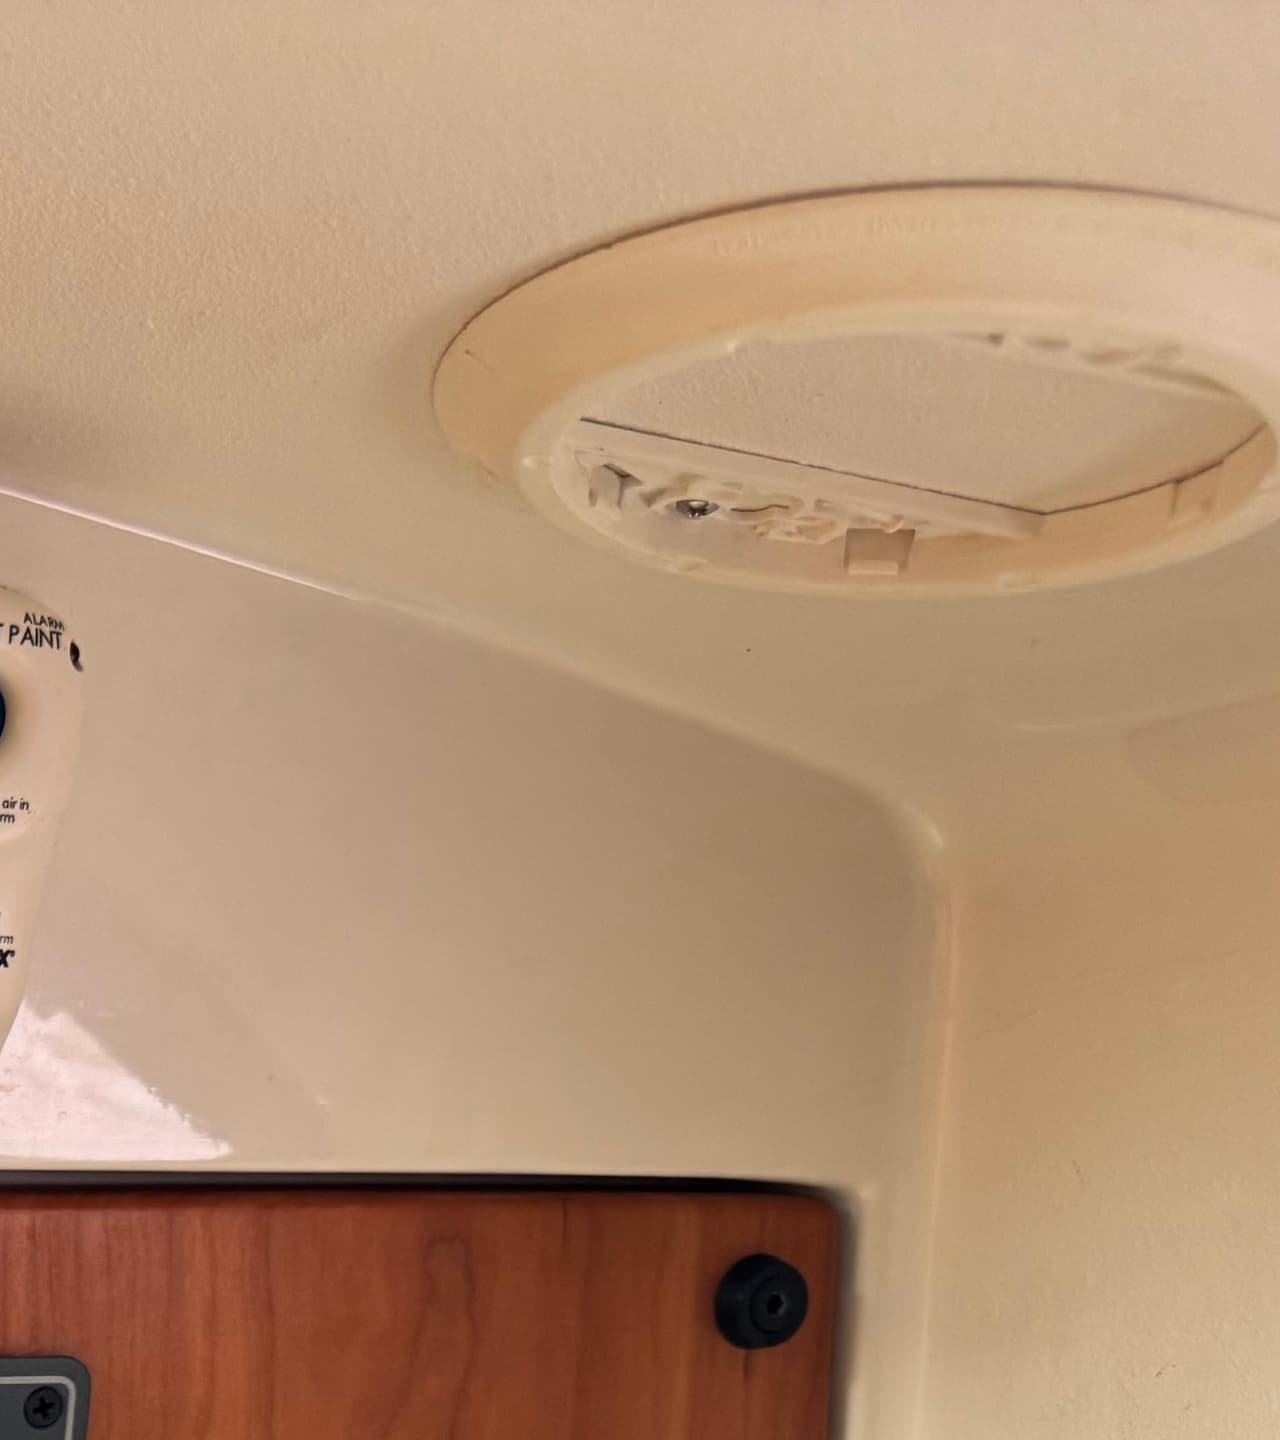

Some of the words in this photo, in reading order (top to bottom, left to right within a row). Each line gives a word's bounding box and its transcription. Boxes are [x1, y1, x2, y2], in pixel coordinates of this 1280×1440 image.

[23, 612, 65, 631] ALARM
[9, 627, 62, 650] PAINT
[2, 798, 17, 810] air
